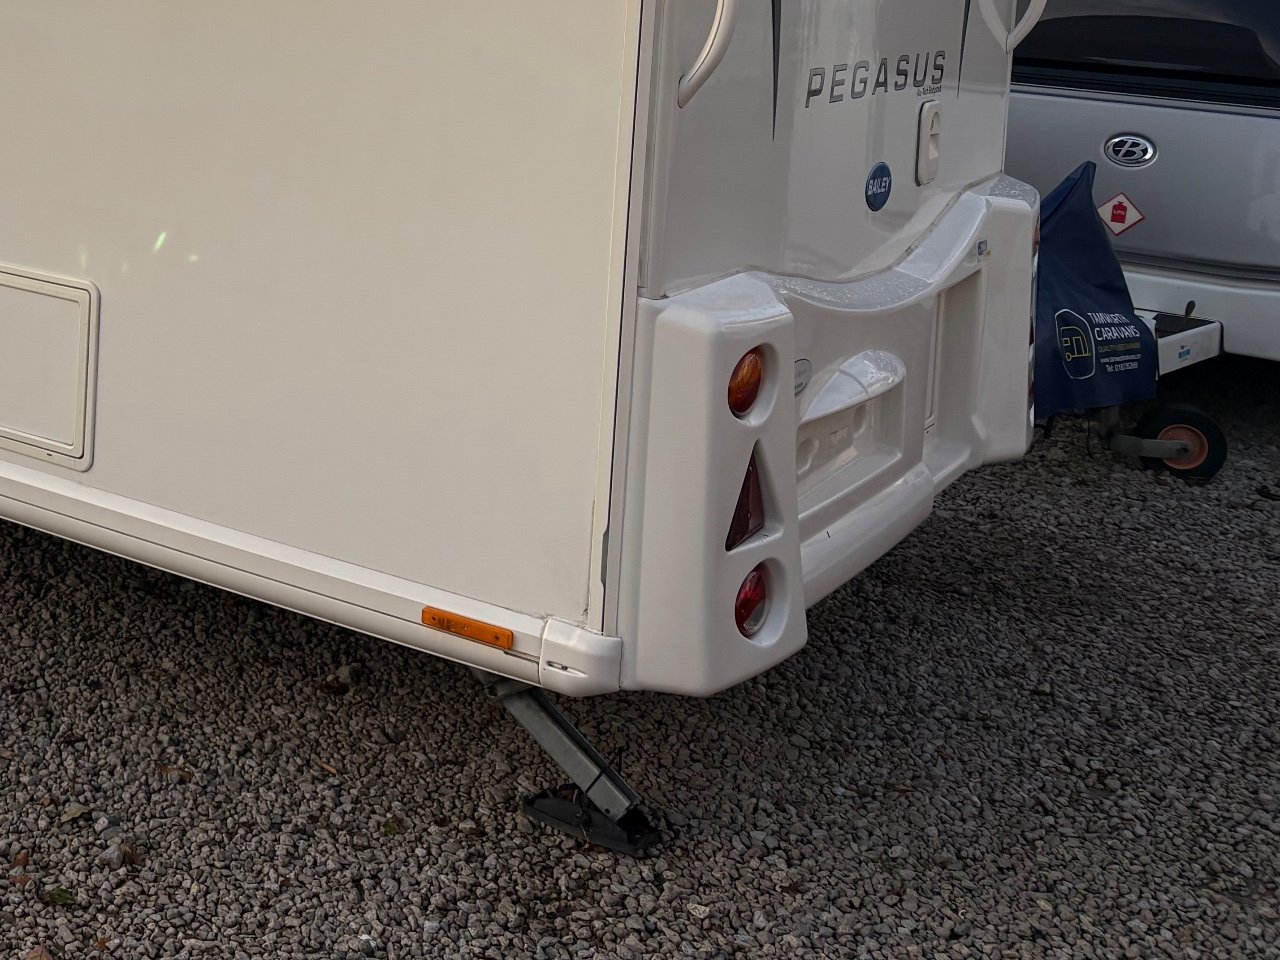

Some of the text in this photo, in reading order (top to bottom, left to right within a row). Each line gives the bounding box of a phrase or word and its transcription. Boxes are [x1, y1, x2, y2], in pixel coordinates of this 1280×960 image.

[804, 50, 946, 108] PEGASUS
[867, 176, 891, 195] BAILEY
[1094, 325, 1140, 341] CARAVANS
